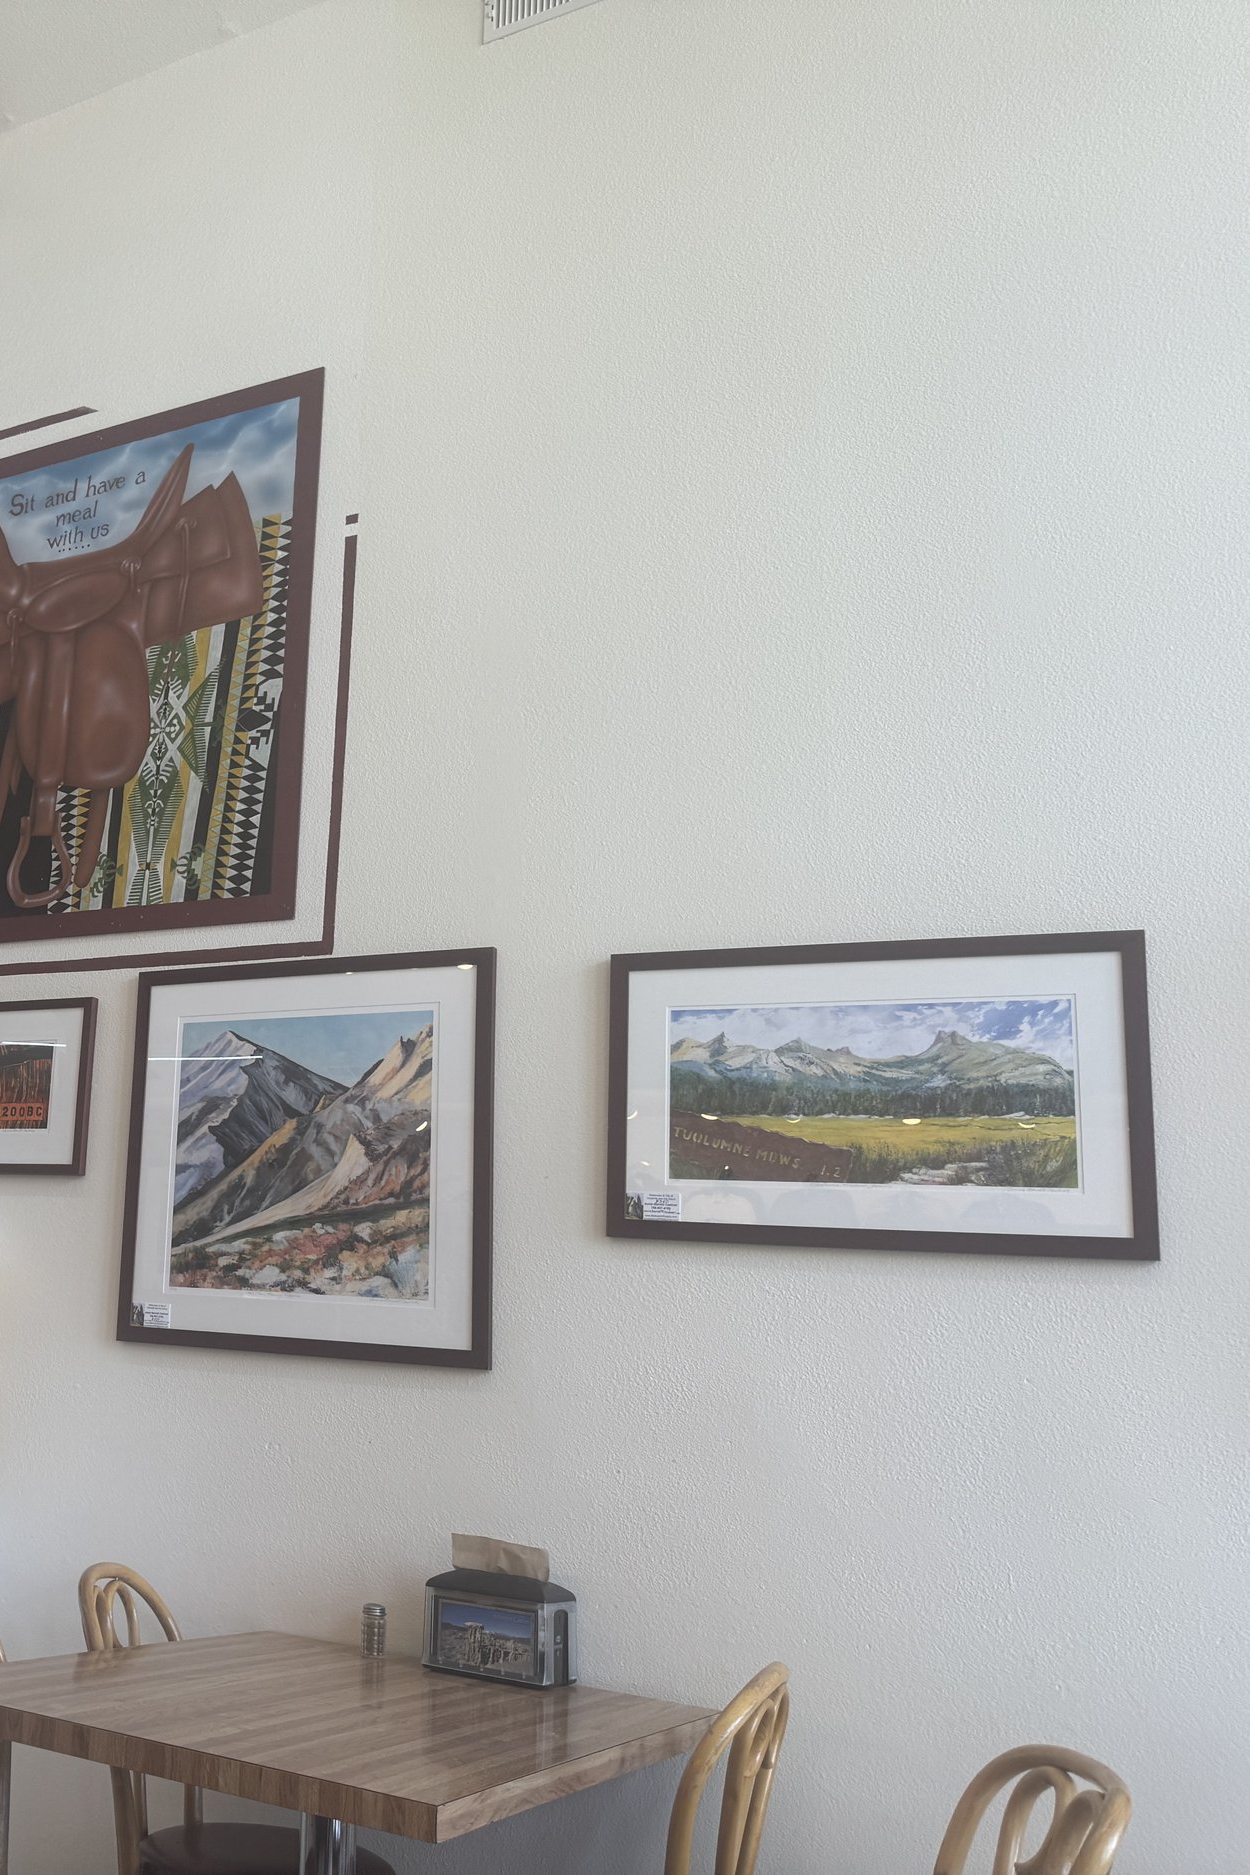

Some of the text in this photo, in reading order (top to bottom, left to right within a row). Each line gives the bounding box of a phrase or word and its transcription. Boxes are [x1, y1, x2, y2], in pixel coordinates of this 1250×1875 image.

[9, 471, 147, 517] Sit and have a
[55, 500, 99, 527] meal
[47, 523, 110, 550] with us
[673, 1126, 751, 1158] TUOLUMNE
